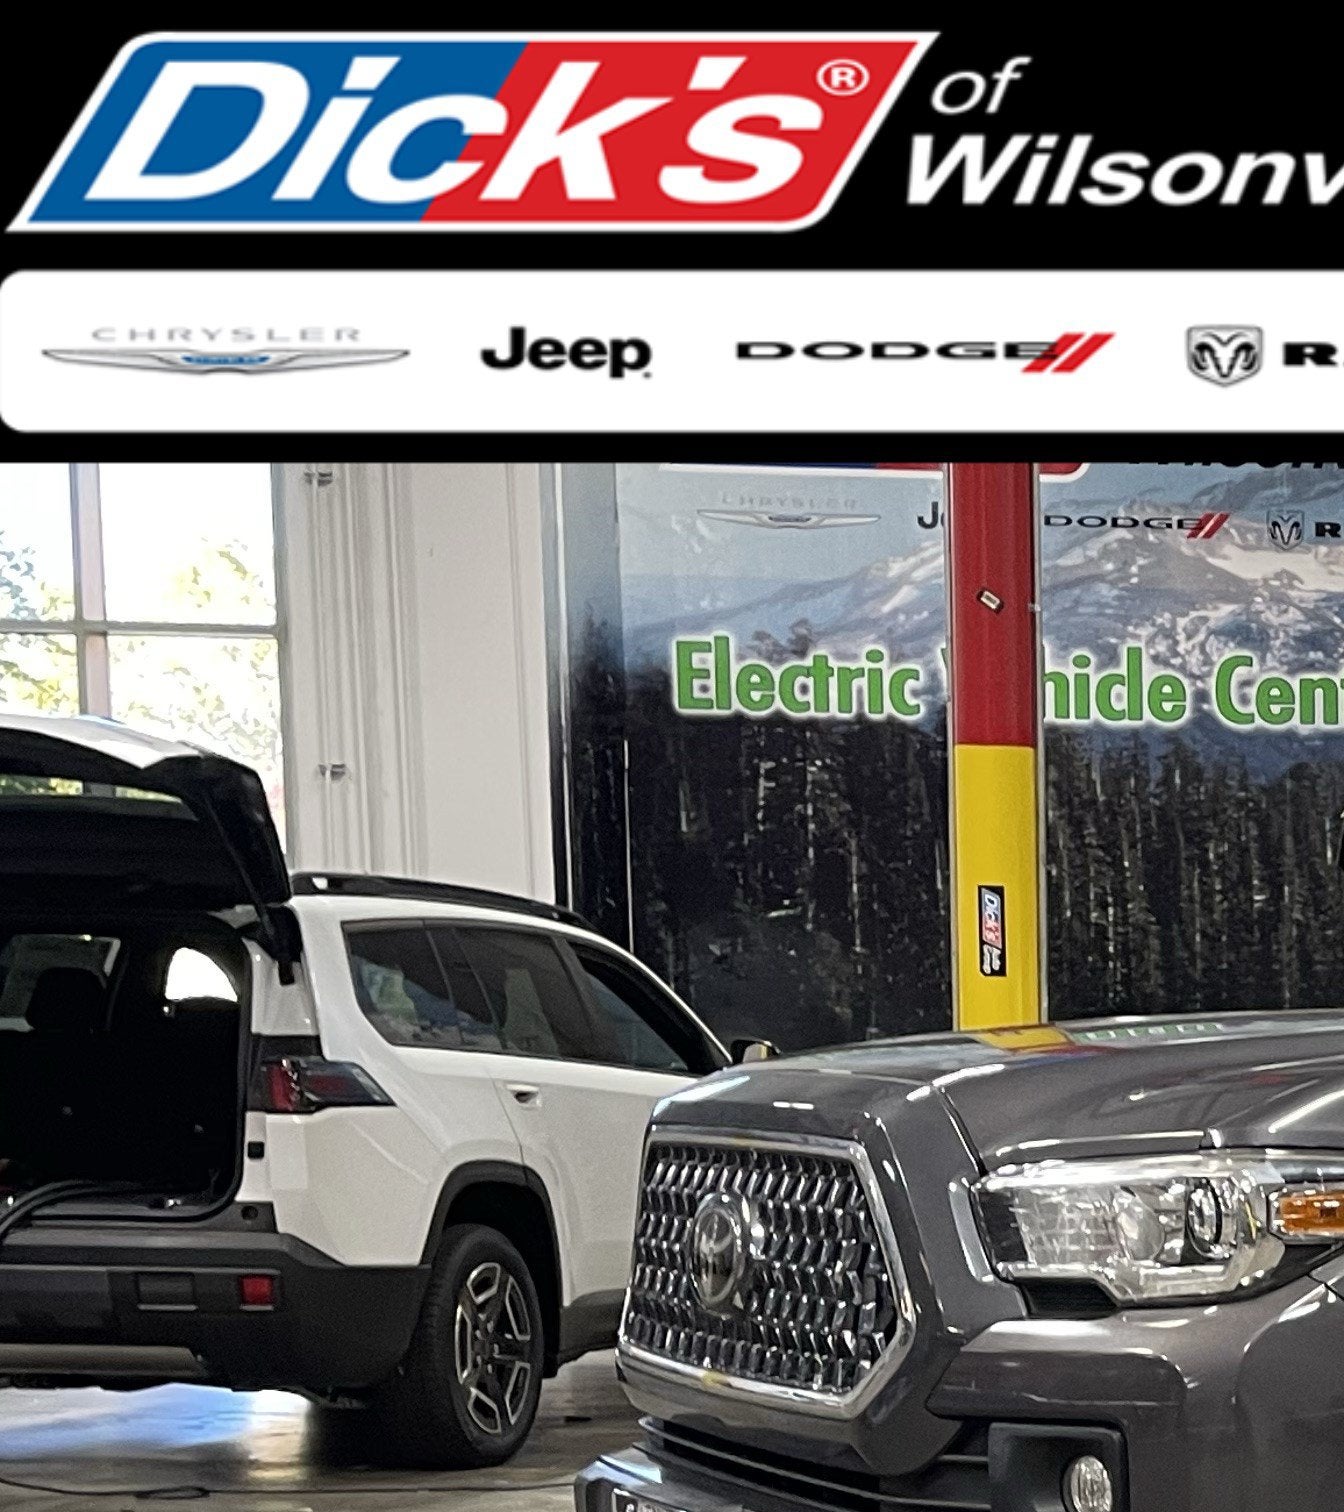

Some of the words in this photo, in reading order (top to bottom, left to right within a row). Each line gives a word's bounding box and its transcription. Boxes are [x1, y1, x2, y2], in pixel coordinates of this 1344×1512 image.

[1044, 514, 1200, 530] DODGE
[676, 636, 921, 718] Electric
[941, 646, 1187, 723] hicle
